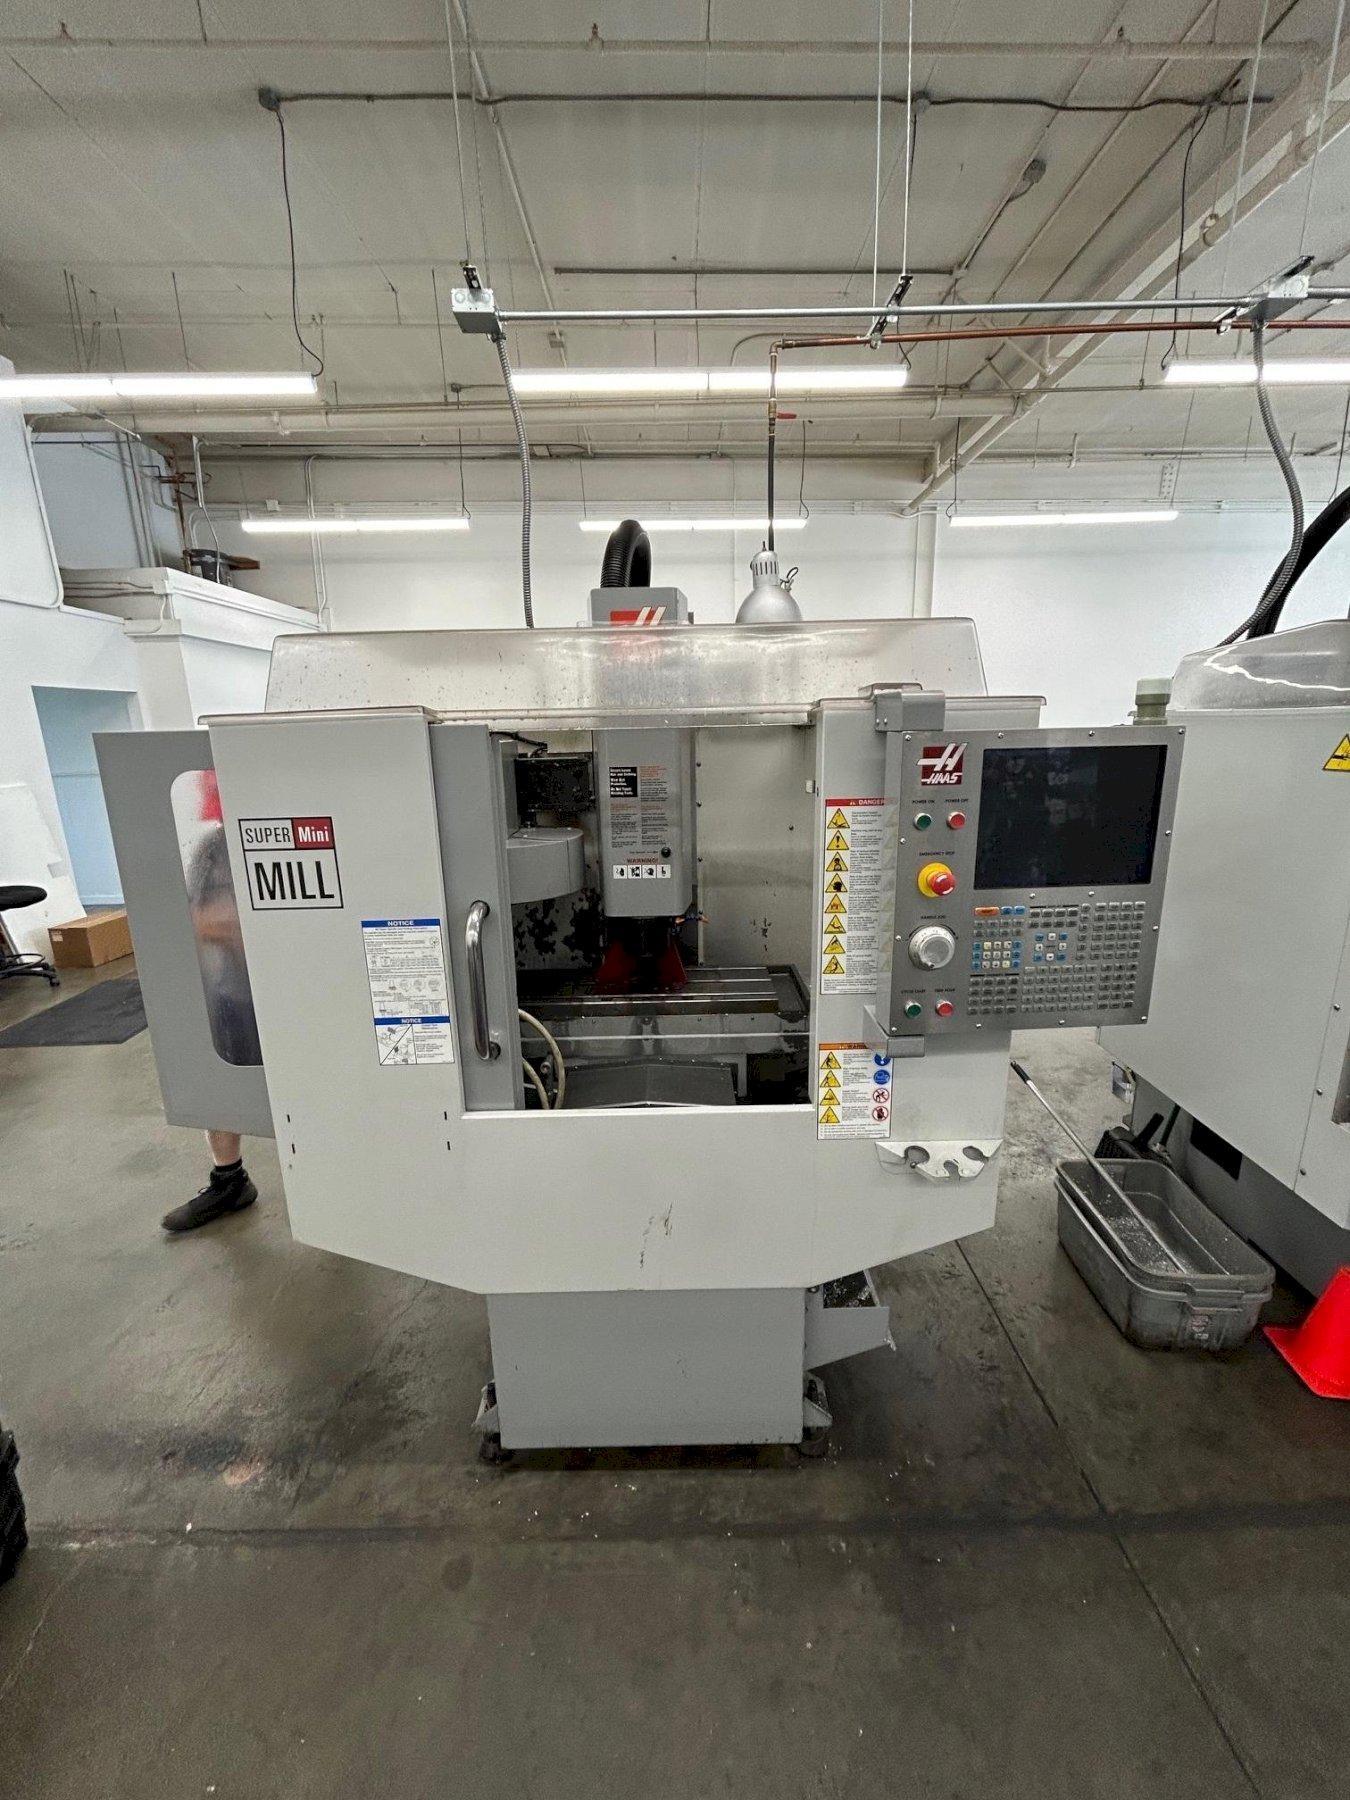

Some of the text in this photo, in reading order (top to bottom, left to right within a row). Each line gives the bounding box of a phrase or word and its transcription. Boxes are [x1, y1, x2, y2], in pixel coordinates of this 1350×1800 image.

[920, 772, 963, 785] HAAS
[245, 826, 330, 843] SUPER Mini
[254, 861, 335, 900] MILL
